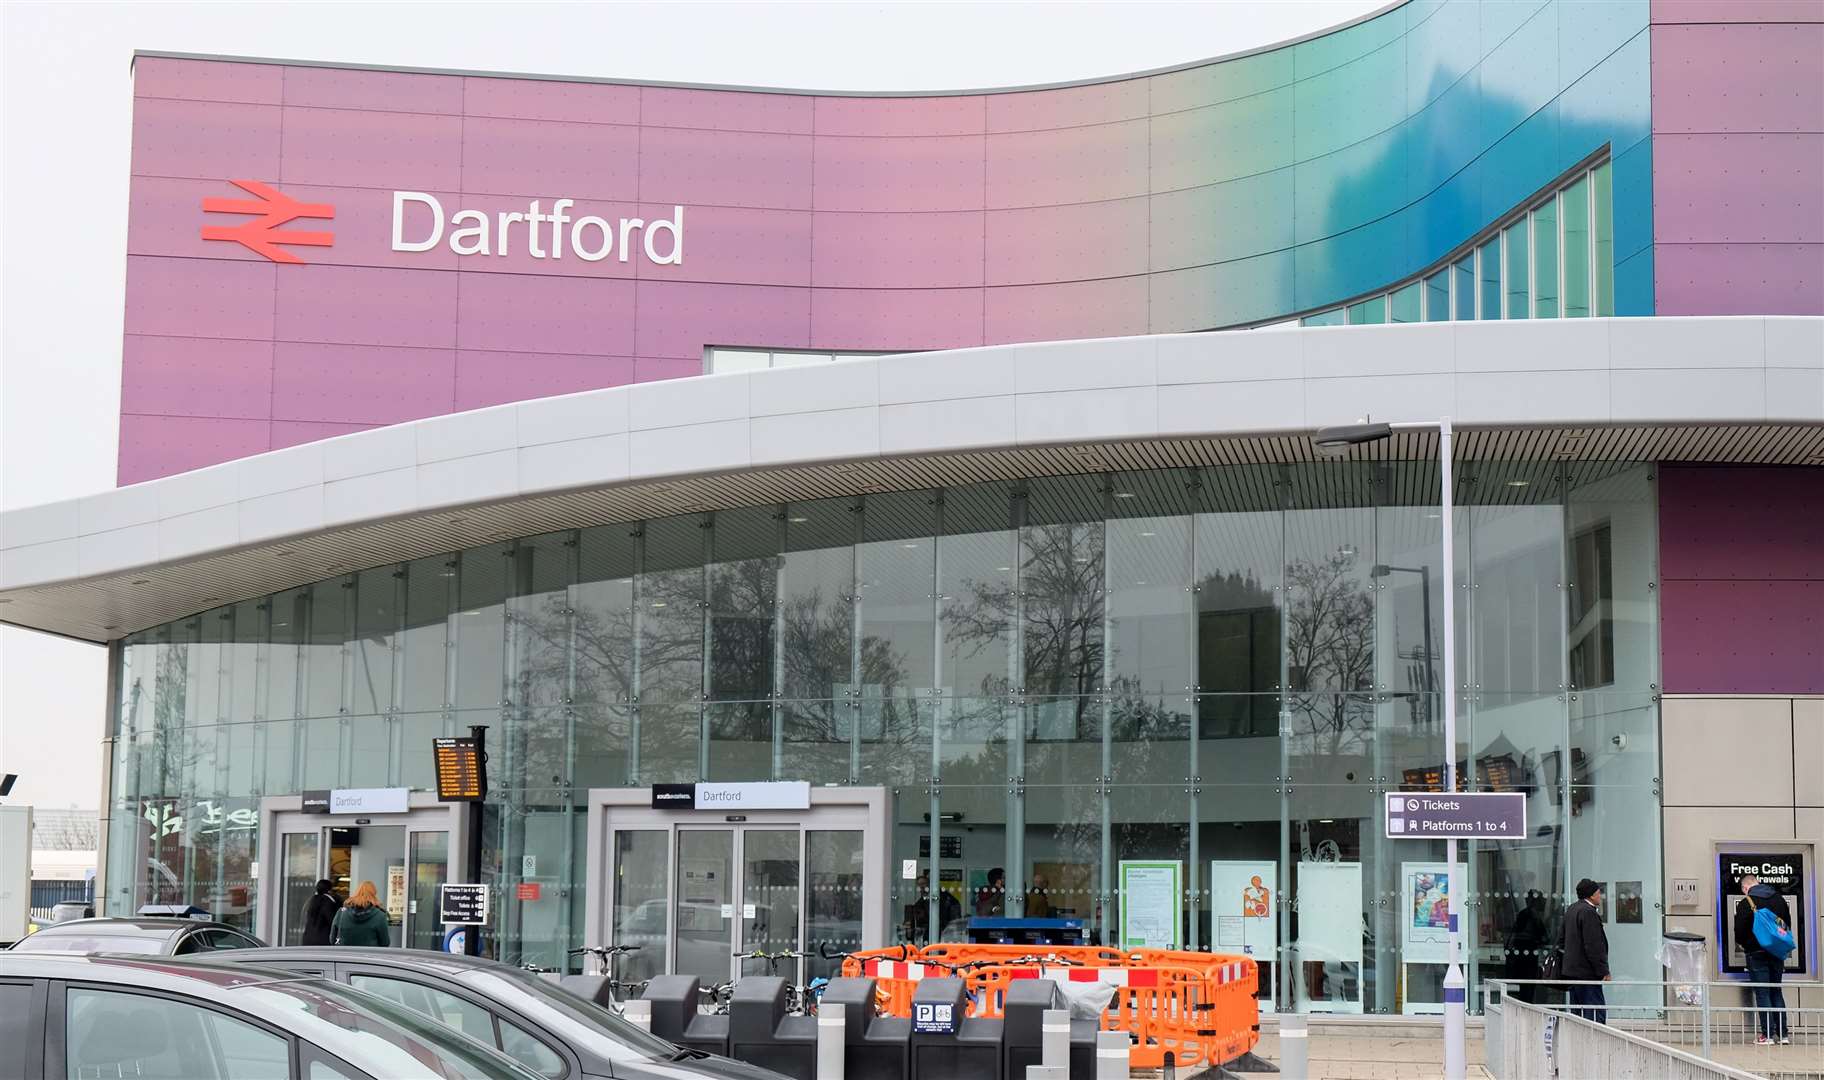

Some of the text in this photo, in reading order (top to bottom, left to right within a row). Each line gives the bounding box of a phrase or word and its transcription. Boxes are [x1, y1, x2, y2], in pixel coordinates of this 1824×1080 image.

[391, 190, 685, 266] Dartford
[335, 796, 362, 807] Dartford
[703, 791, 742, 801] Dartford
[1422, 799, 1460, 811] Tickets
[1422, 820, 1507, 832] Platforms 1 to 4
[1730, 862, 1793, 875] Free Cash
[920, 1008, 930, 1019] P
